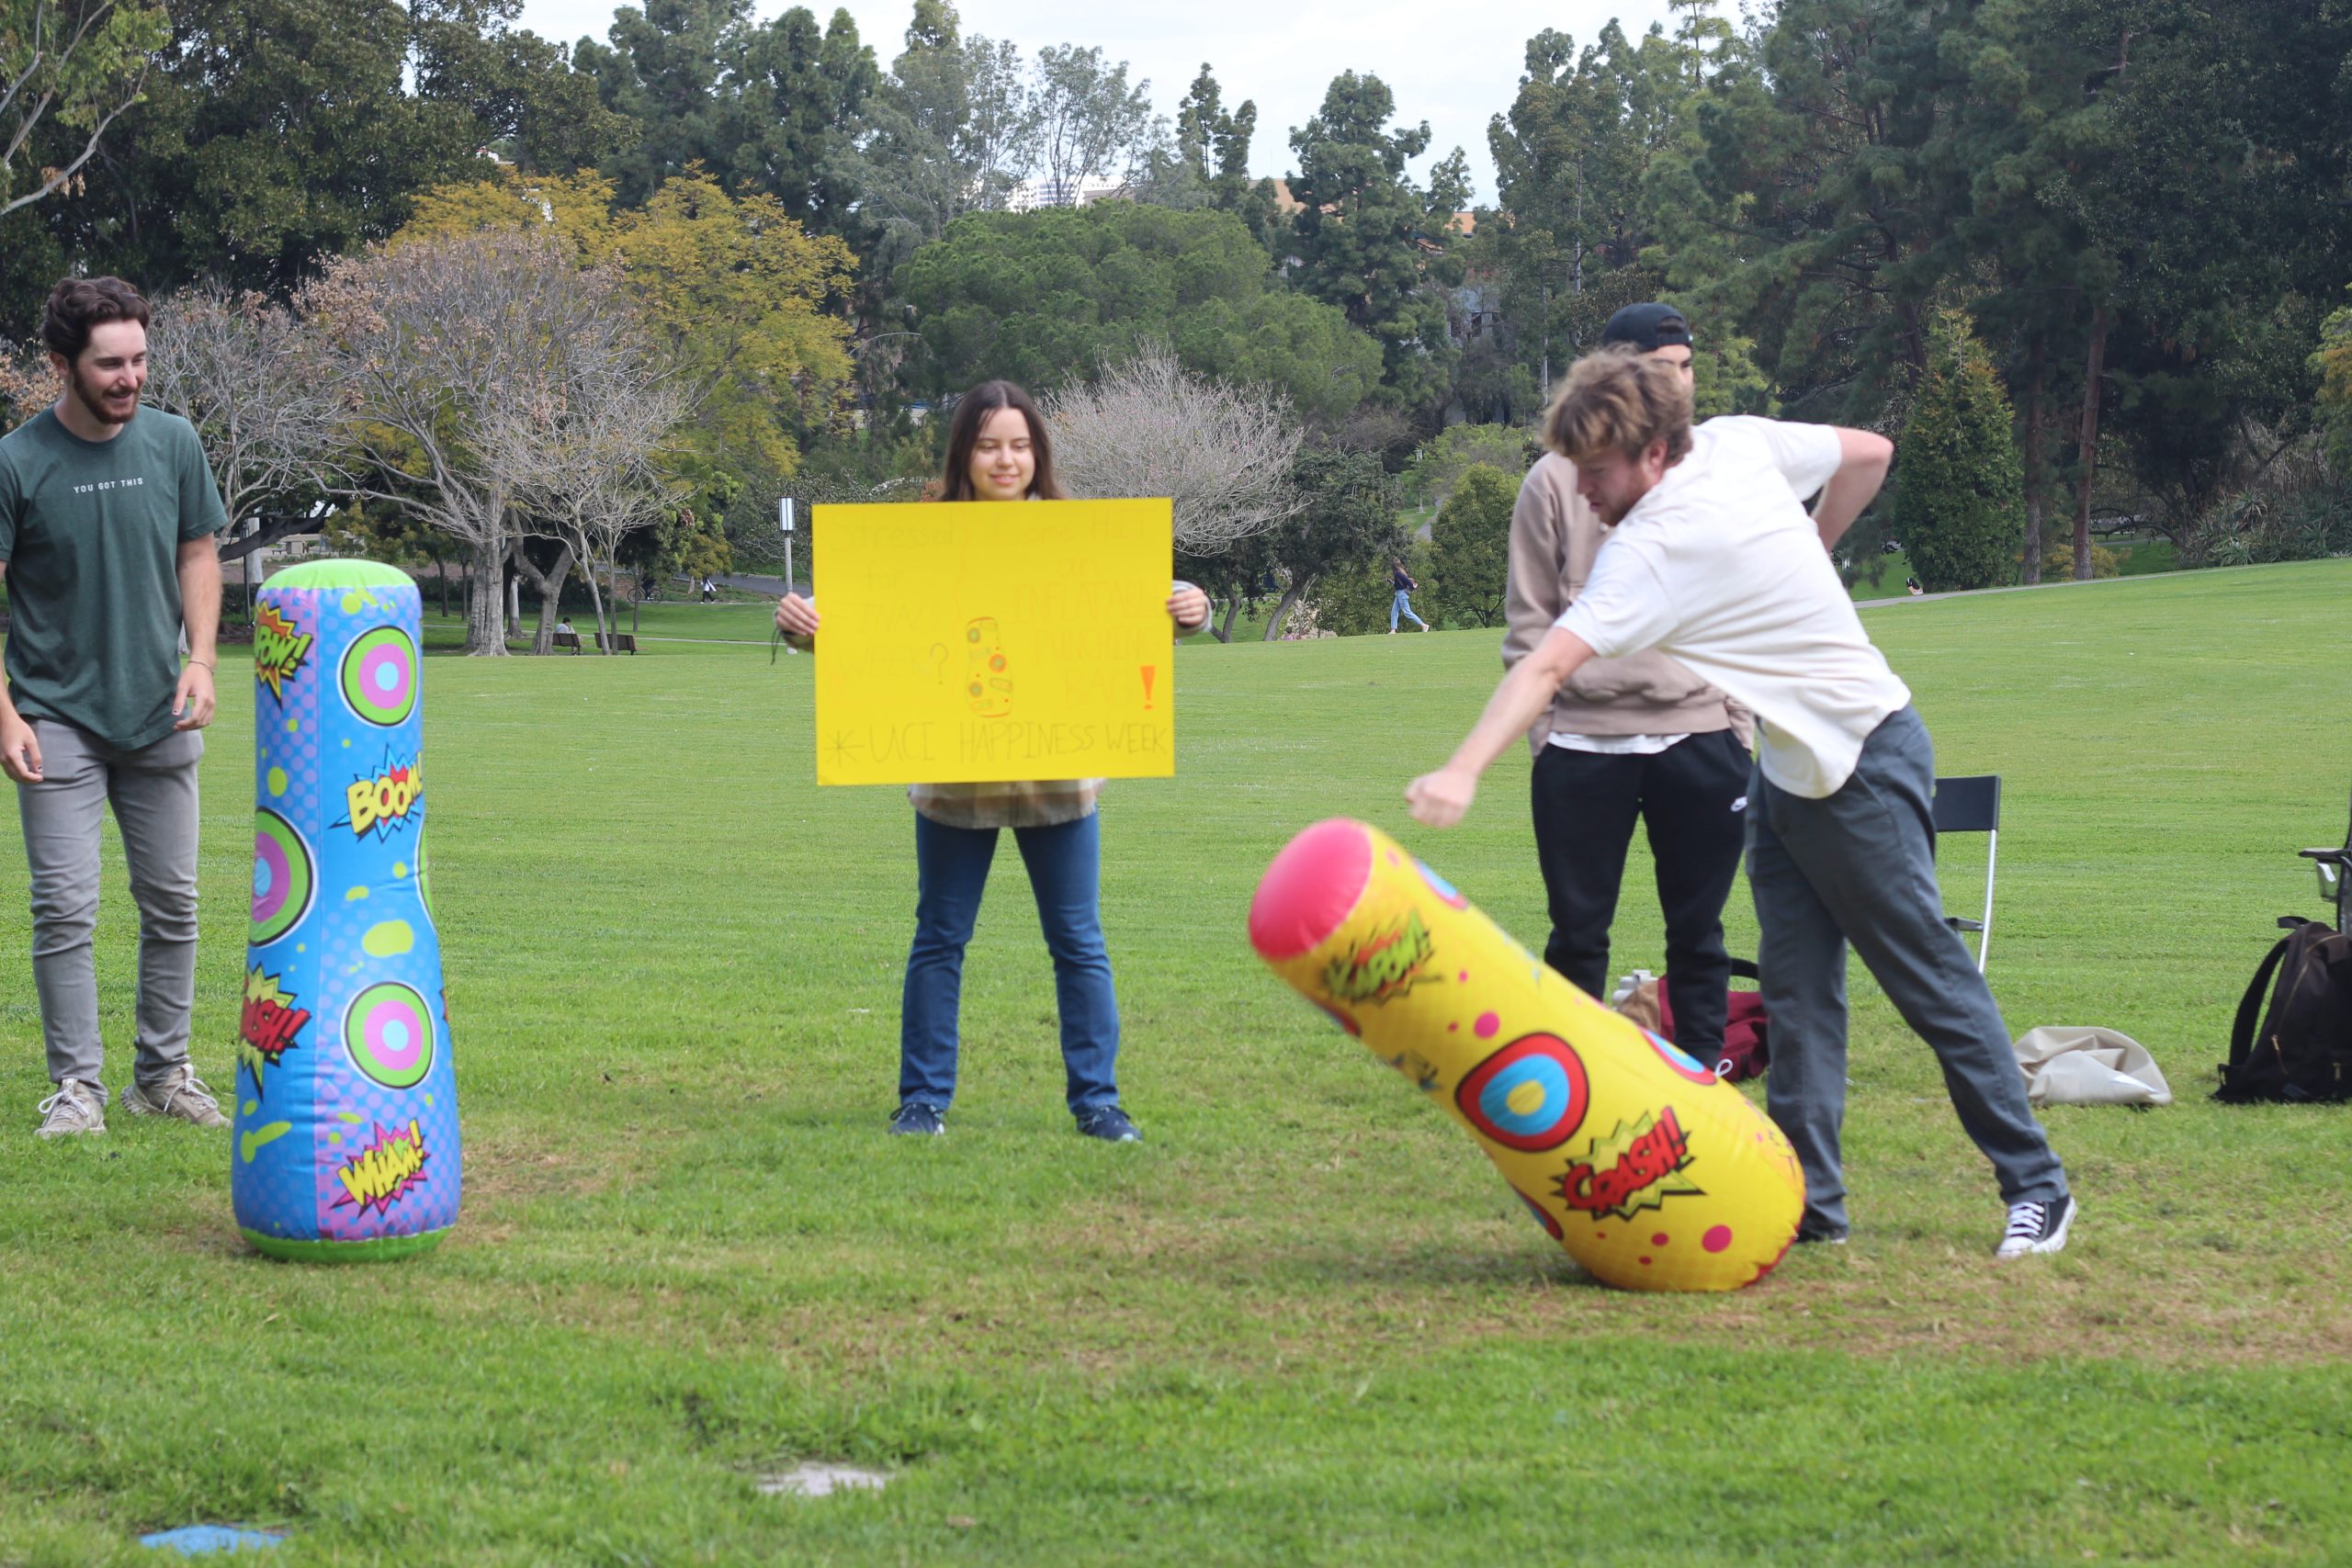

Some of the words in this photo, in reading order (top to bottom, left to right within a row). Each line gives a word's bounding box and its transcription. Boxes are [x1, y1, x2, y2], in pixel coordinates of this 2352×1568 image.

[74, 484, 94, 493] YOU
[97, 480, 116, 490] GOT
[120, 477, 143, 488] THIS
[831, 509, 953, 550] Stressed
[1092, 506, 1159, 540] HIT
[864, 558, 905, 592] for
[1057, 557, 1101, 579] an
[823, 600, 944, 634] FINALS
[1007, 580, 1168, 625] INFLATABLE
[1035, 626, 1160, 668] PUNCHING
[959, 720, 1096, 764] HAPPINESS
[1105, 720, 1170, 756] WEEK
[346, 751, 423, 834] BOOM!
[1328, 908, 1430, 998] KAPOW!
[337, 1119, 424, 1207] WHAM!
[1564, 1105, 1687, 1212] CRASH!
